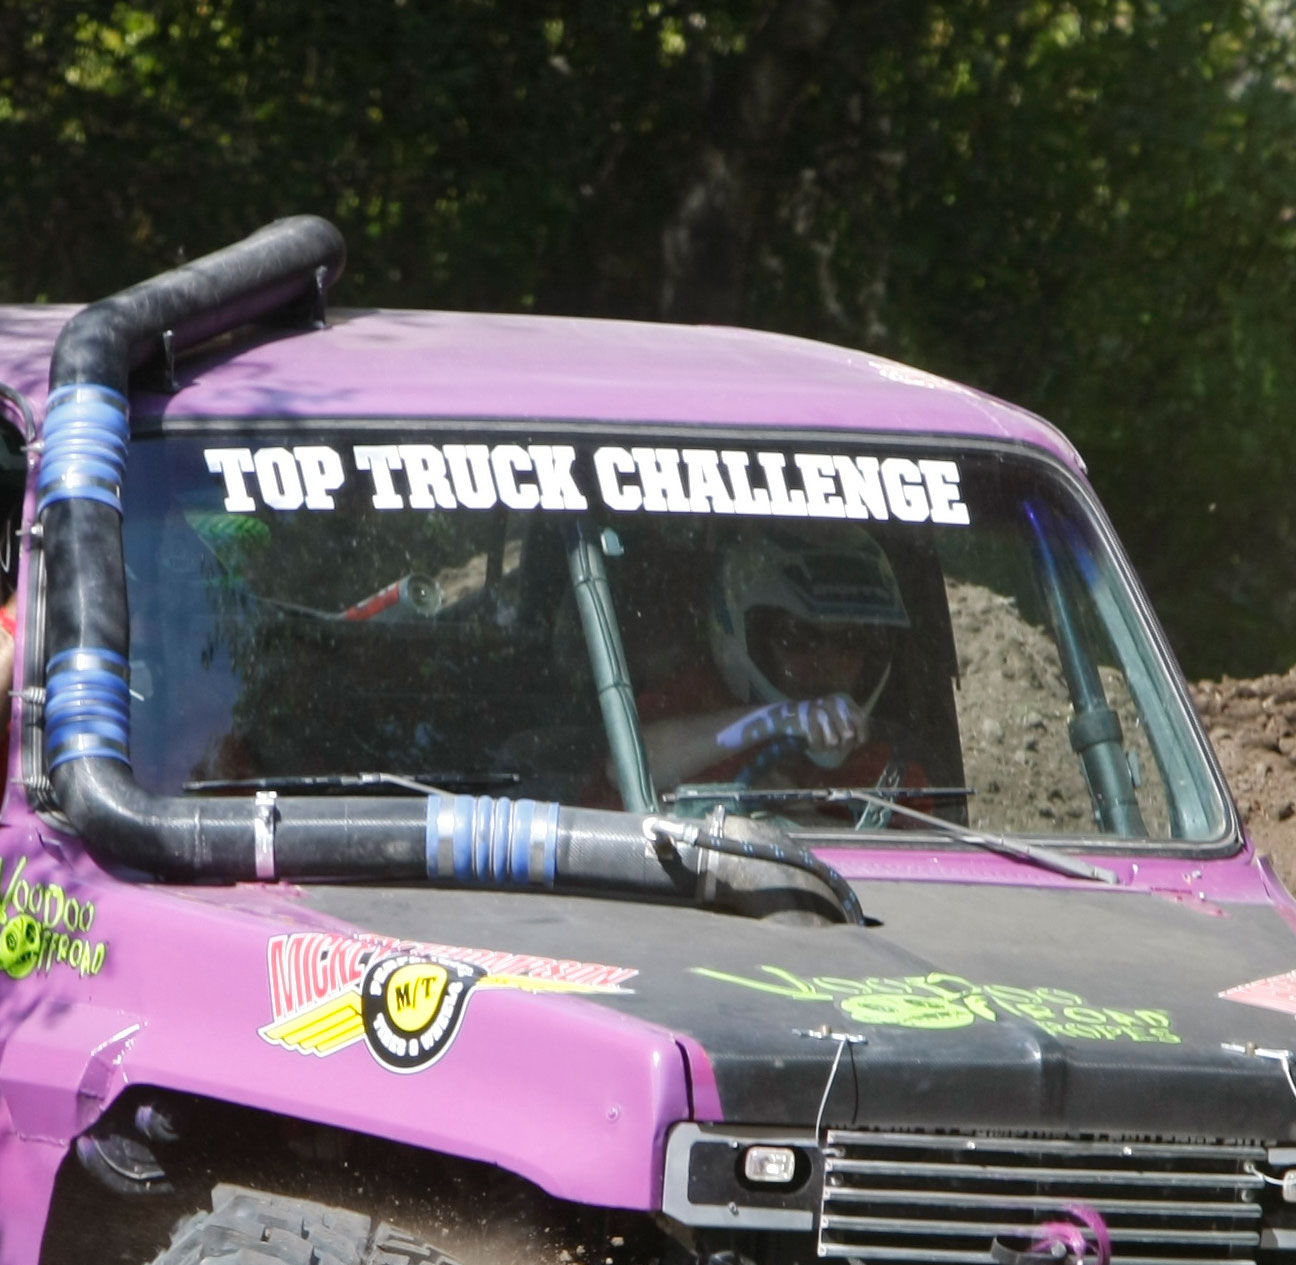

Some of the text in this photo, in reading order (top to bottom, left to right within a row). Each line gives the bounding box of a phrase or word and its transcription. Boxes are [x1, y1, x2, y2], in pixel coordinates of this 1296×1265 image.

[204, 445, 971, 526] TOP TRUCK CHALLENGE
[395, 976, 437, 1012] M/T
